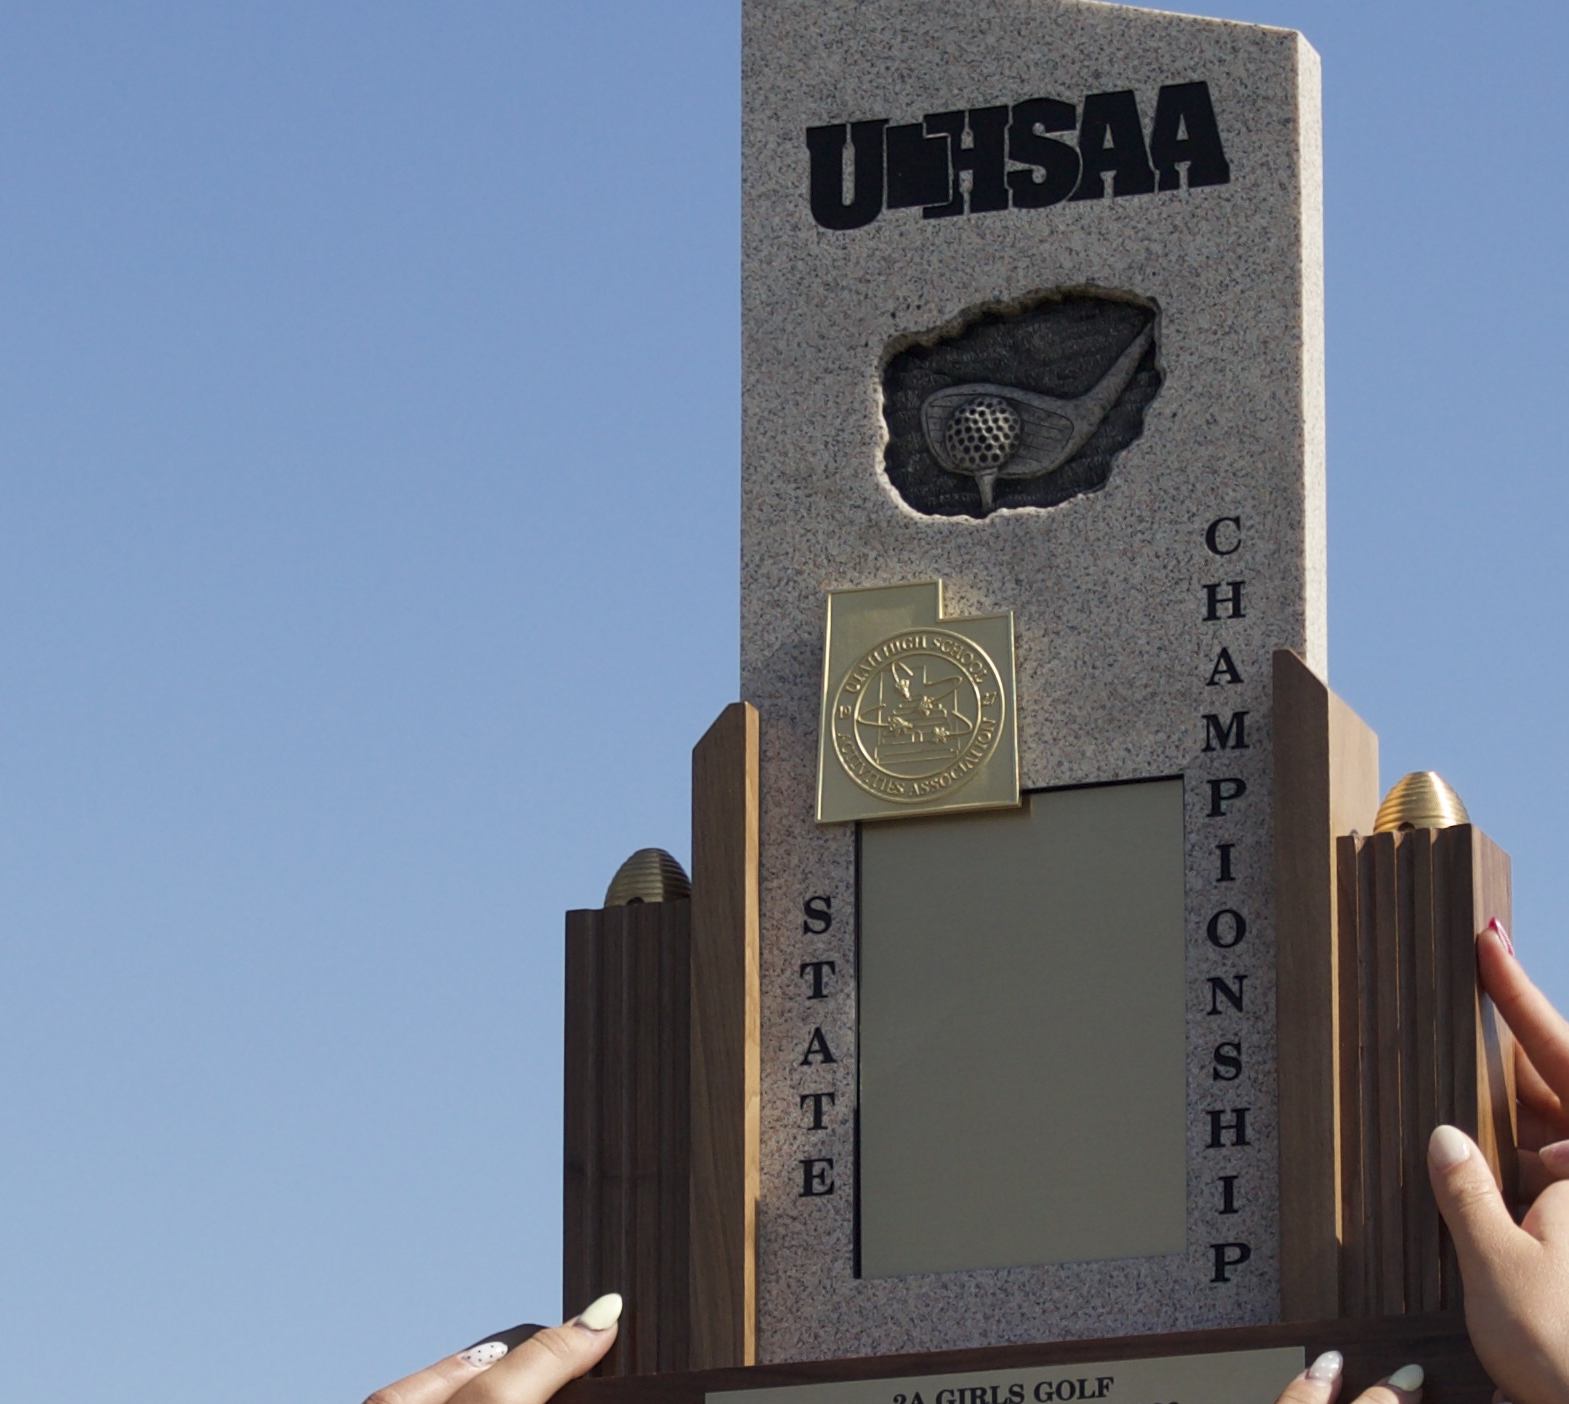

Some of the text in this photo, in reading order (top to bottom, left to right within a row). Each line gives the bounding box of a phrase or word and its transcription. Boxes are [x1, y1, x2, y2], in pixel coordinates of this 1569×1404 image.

[805, 80, 1230, 231] UHSAA
[845, 634, 988, 693] UTAH HIGH SCHOOL
[837, 716, 997, 796] ACTIVITIES ASSOCIATION
[1201, 515, 1252, 1283] CHAMPIONSHIP
[798, 896, 837, 1198] STATE
[1033, 1376, 1114, 1404] GOLF
